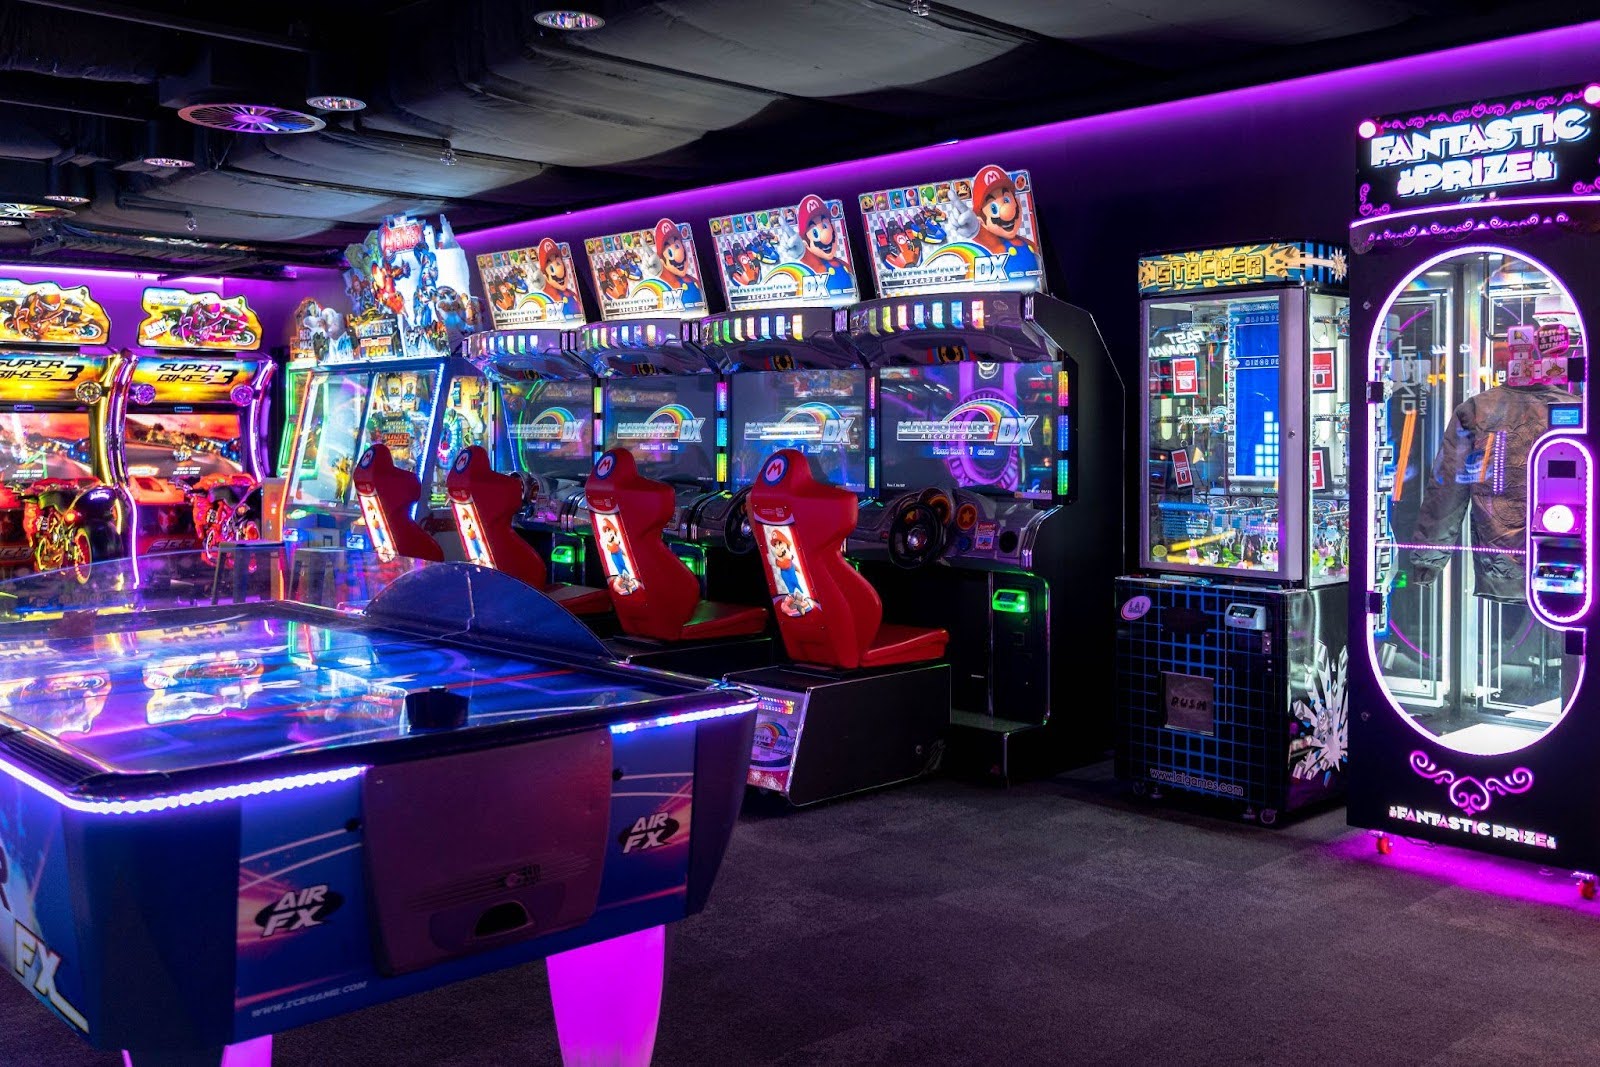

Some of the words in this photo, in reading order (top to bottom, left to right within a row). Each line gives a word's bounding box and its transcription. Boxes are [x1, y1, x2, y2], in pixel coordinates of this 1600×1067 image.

[1371, 108, 1591, 168] FANTASTIC
[1413, 151, 1533, 195] PRIZE
[973, 253, 1010, 284] DX
[1157, 254, 1265, 286] STACKER
[662, 288, 686, 312] DX
[802, 273, 831, 300] DX
[49, 364, 85, 381] 3
[157, 363, 223, 372] SUPER
[157, 373, 212, 382] BIKES
[205, 369, 239, 385] 3
[561, 418, 586, 442] DX
[678, 417, 706, 442] DX
[821, 417, 855, 444] DX
[994, 415, 1039, 446] DX
[968, 446, 974, 456] 1
[1171, 696, 1207, 711] PUSH
[1150, 768, 1243, 796] www.laigames.com
[630, 812, 669, 833] AIR
[1397, 806, 1491, 836] FANTASTIC
[1492, 824, 1547, 848] PRIZE
[623, 829, 666, 854] FX
[273, 885, 328, 911] AIR
[263, 905, 324, 937] FX
[15, 919, 89, 1034] FX
[252, 981, 368, 1017] WWW.ICEGAME.COM
